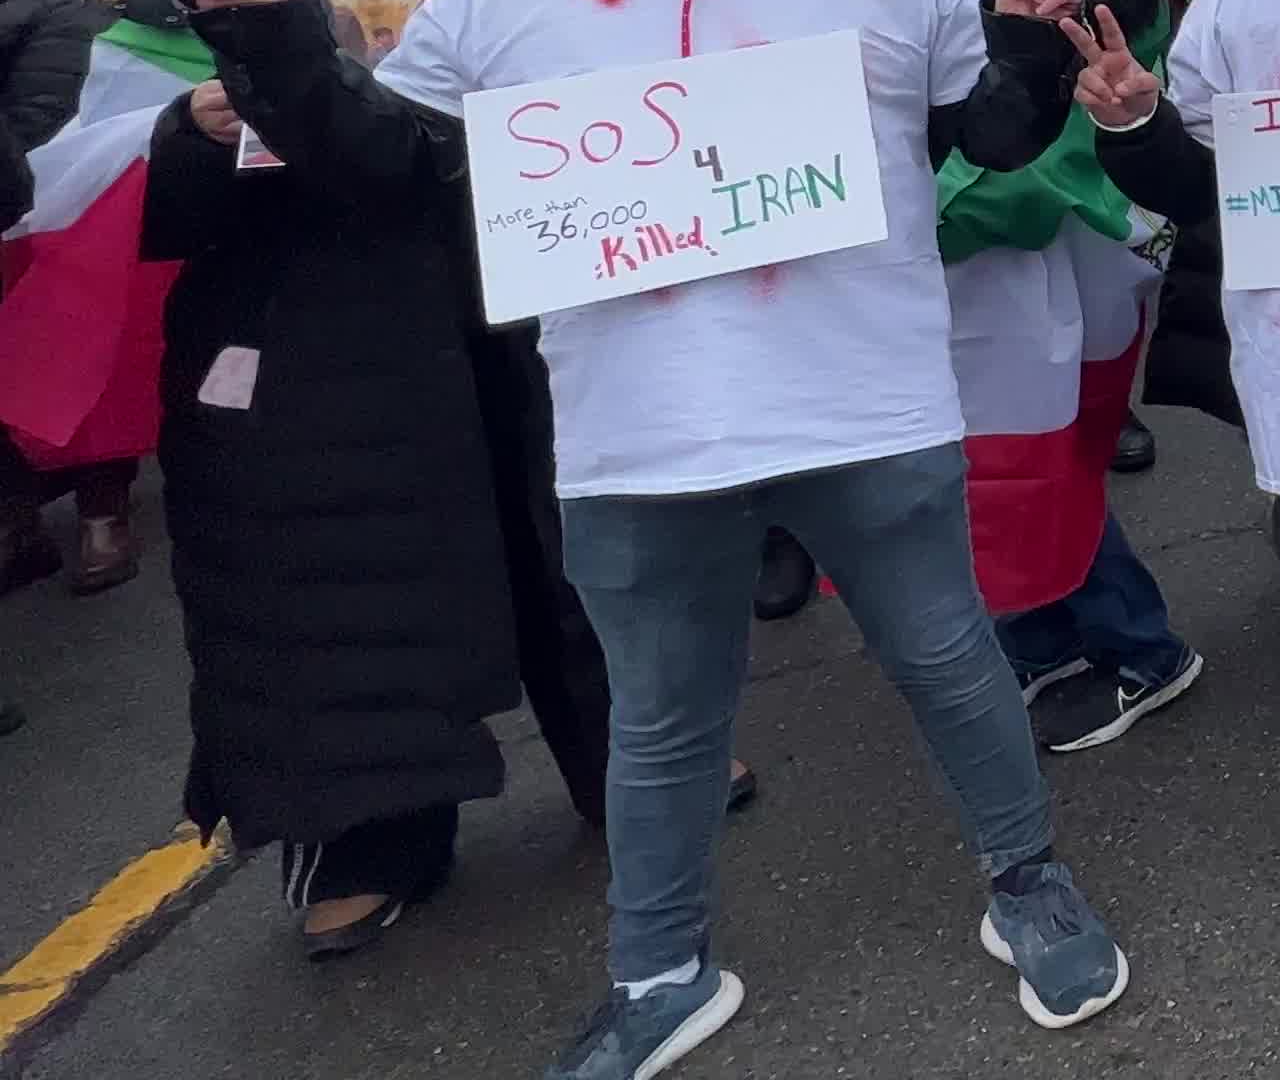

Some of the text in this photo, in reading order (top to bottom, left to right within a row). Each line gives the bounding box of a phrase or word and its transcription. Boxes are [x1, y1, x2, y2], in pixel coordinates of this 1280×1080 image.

[693, 145, 723, 182] 4
[486, 195, 589, 233] More than
[711, 153, 845, 237] IRAN
[527, 199, 648, 254] 36,000
